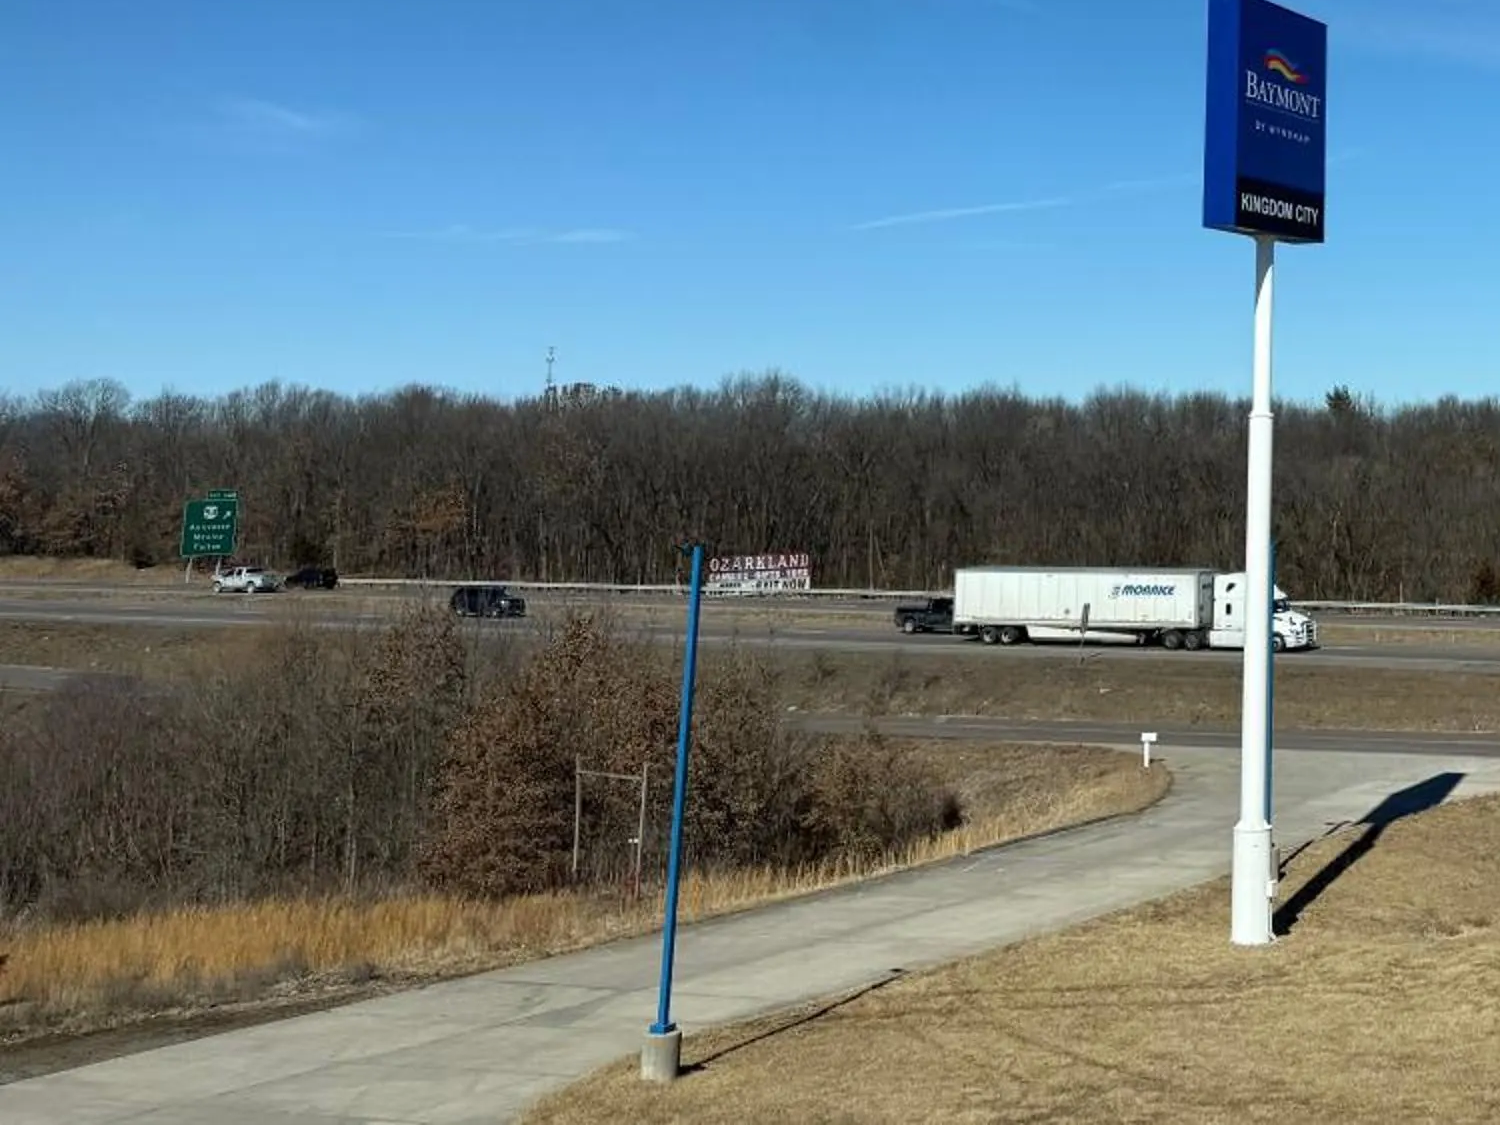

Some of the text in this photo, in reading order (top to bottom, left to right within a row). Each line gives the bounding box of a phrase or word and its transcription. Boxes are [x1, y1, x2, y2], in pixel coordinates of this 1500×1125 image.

[1246, 70, 1321, 117] BAYMONT
[1241, 192, 1319, 226] KINGDOM CITY
[709, 554, 809, 572] OZARKLAND
